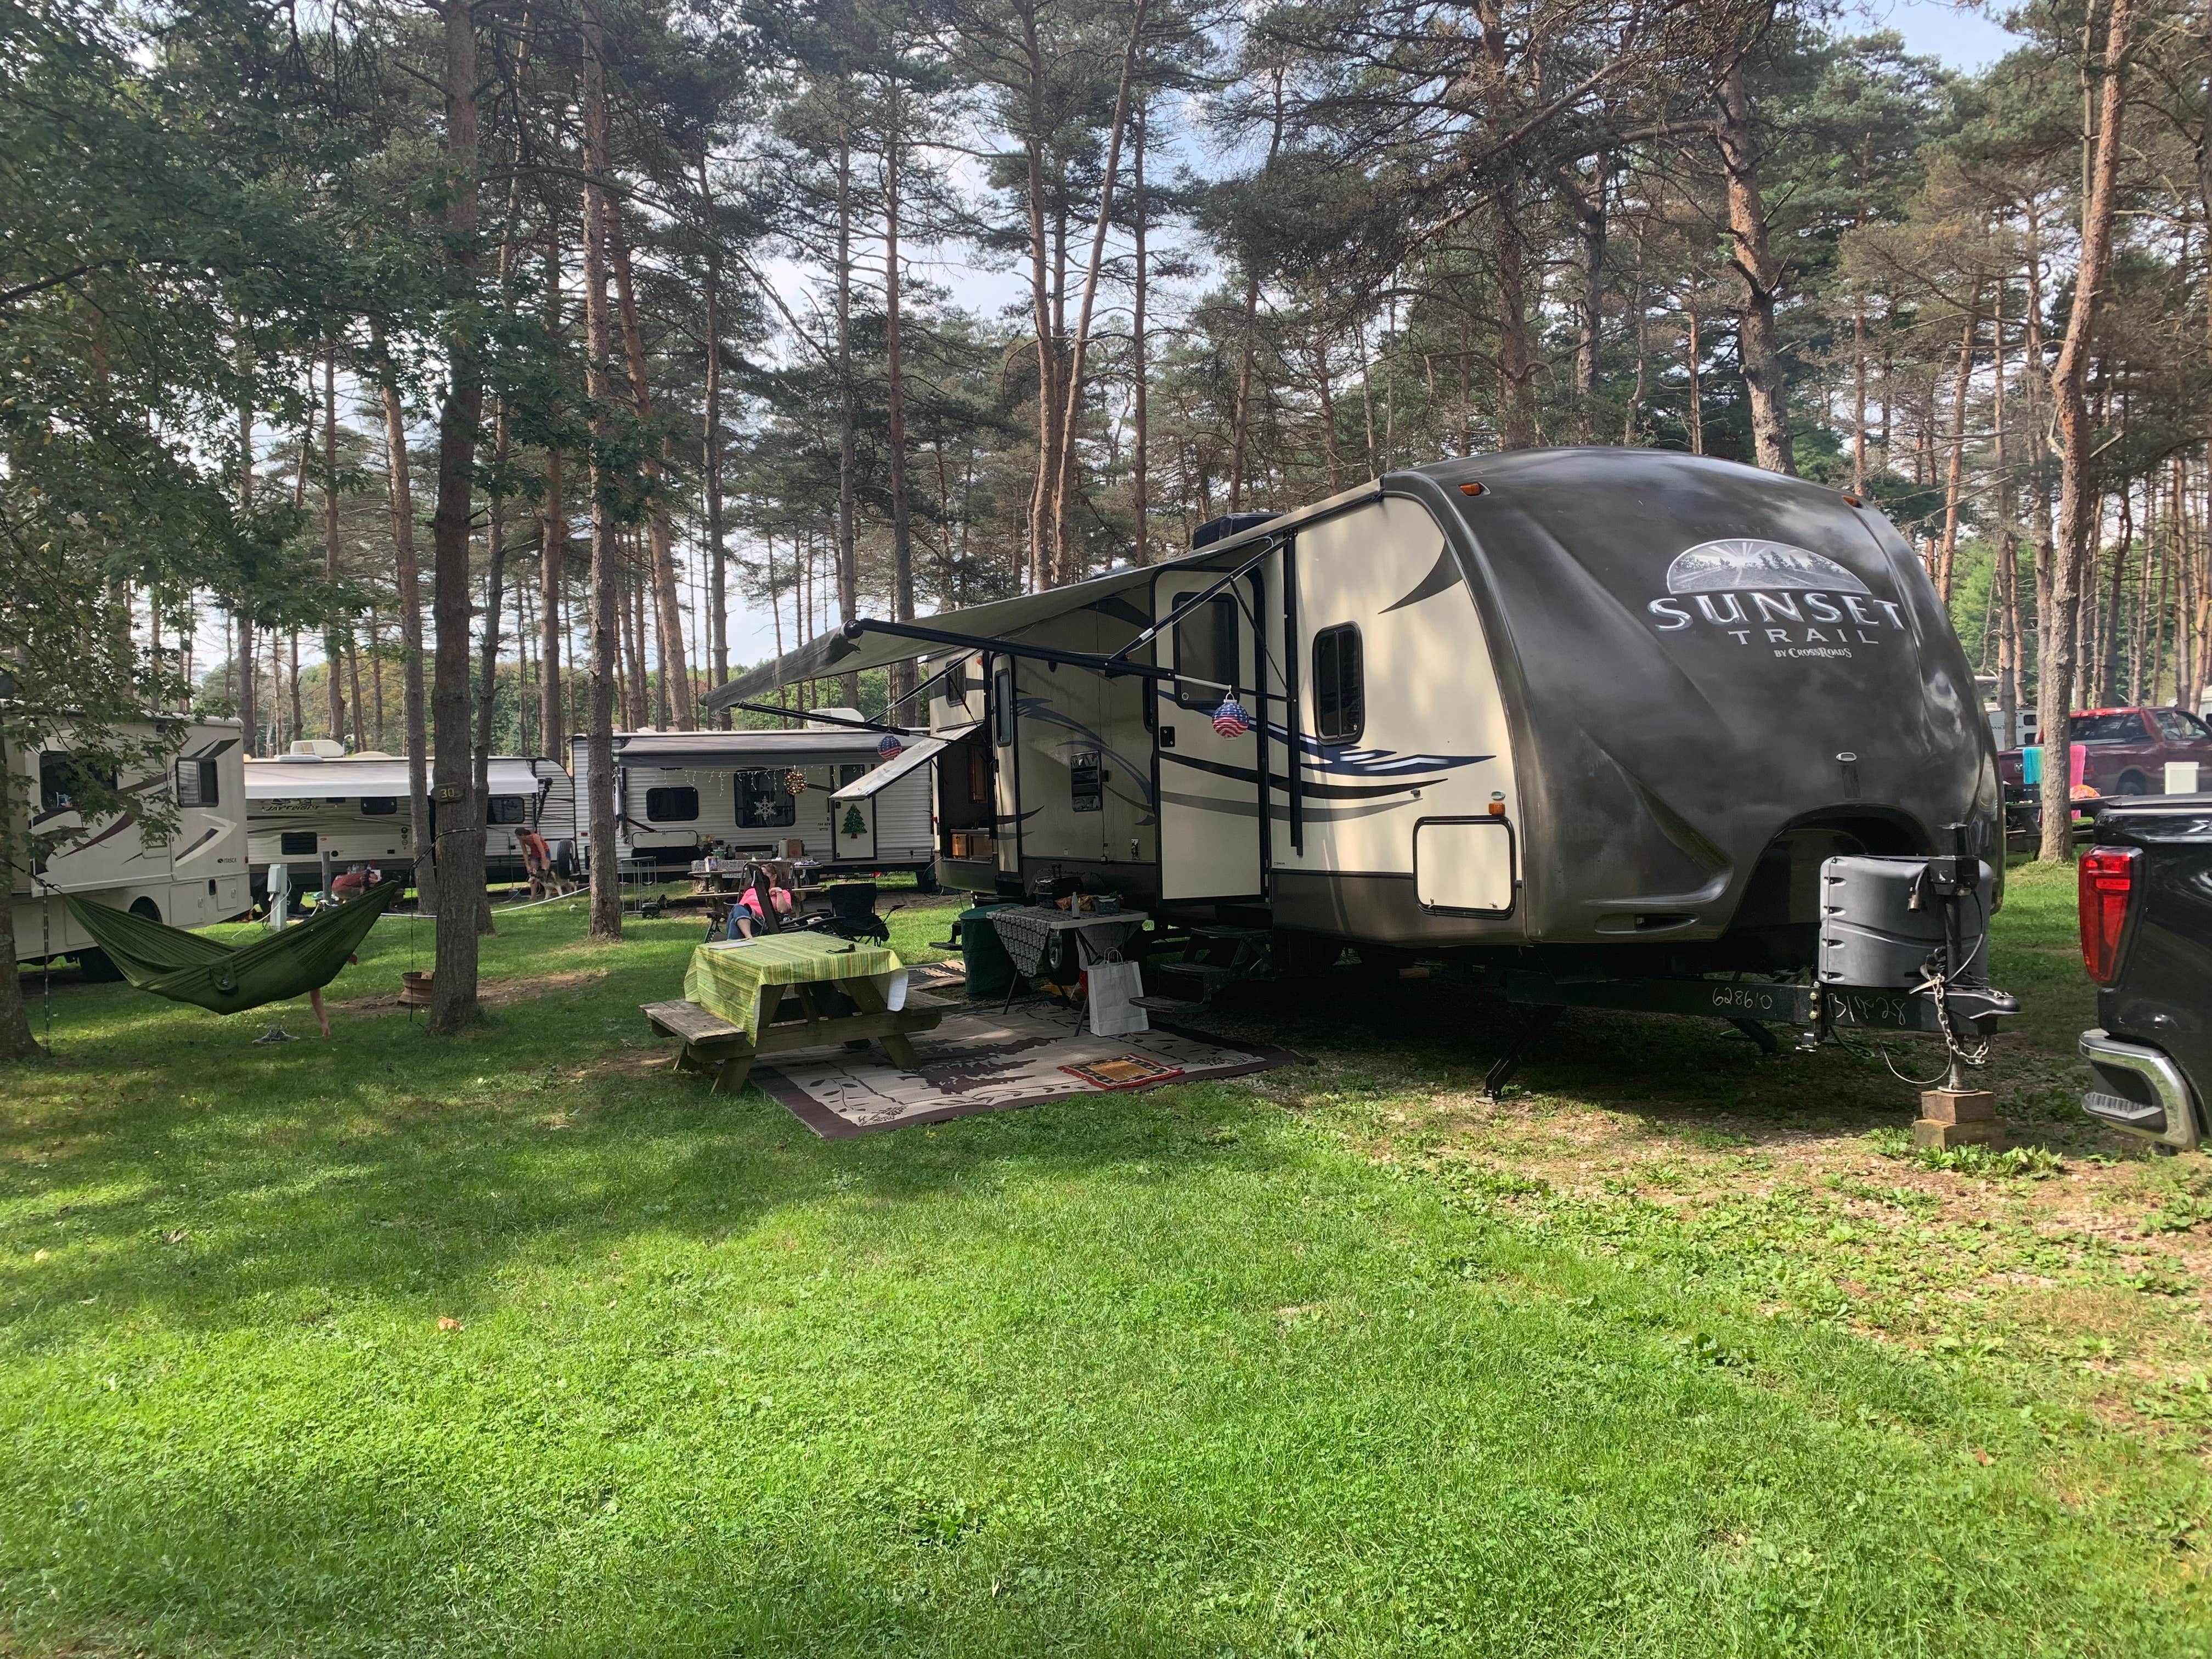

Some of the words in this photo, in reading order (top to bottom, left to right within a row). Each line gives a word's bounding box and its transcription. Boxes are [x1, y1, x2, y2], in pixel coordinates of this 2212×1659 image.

[1647, 592, 1906, 631] SUNSET
[1728, 628, 1879, 645] TRAIL
[440, 788, 455, 798] 30
